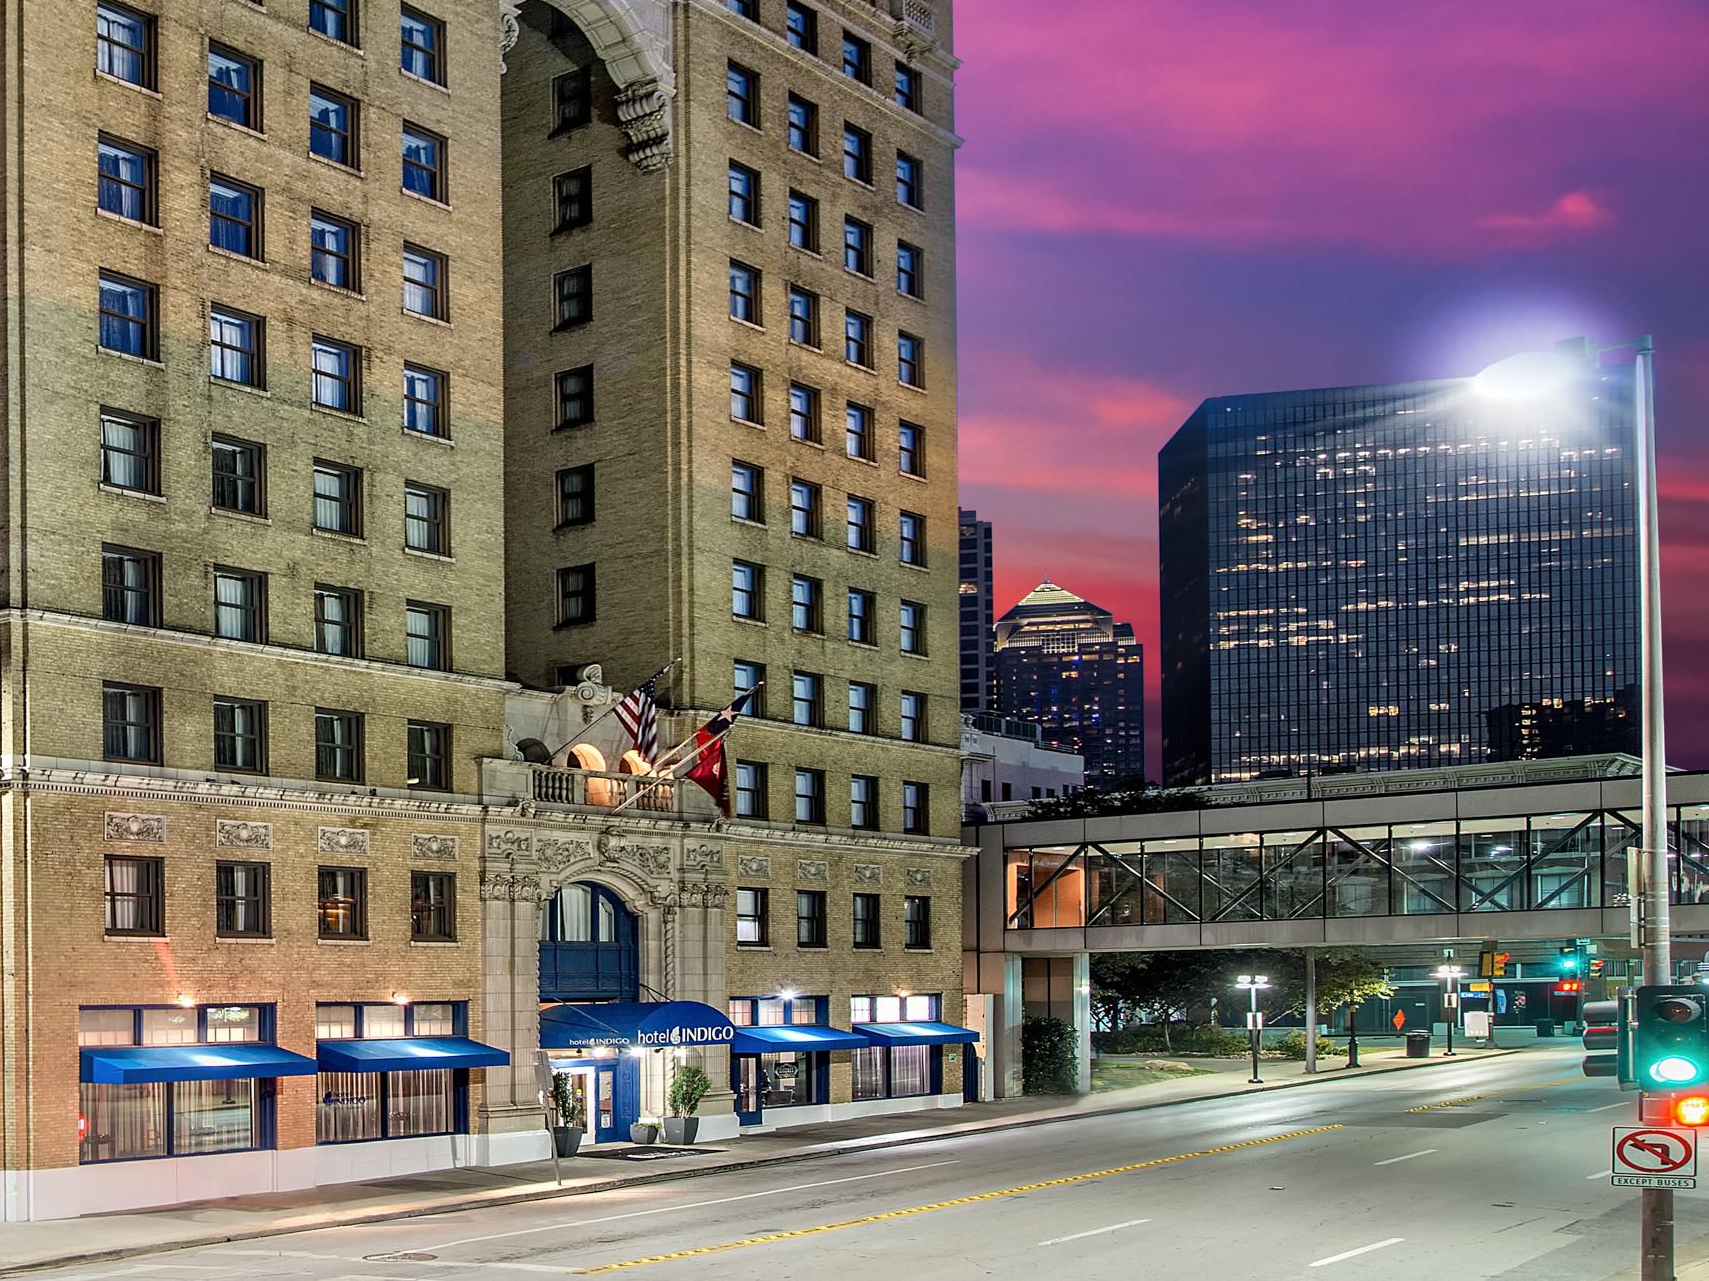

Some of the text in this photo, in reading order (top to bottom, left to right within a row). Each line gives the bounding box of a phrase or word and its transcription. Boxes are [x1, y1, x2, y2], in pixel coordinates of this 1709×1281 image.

[637, 1025, 733, 1044] hotel INDIGO
[1618, 1178, 1652, 1186] EXCEPT
